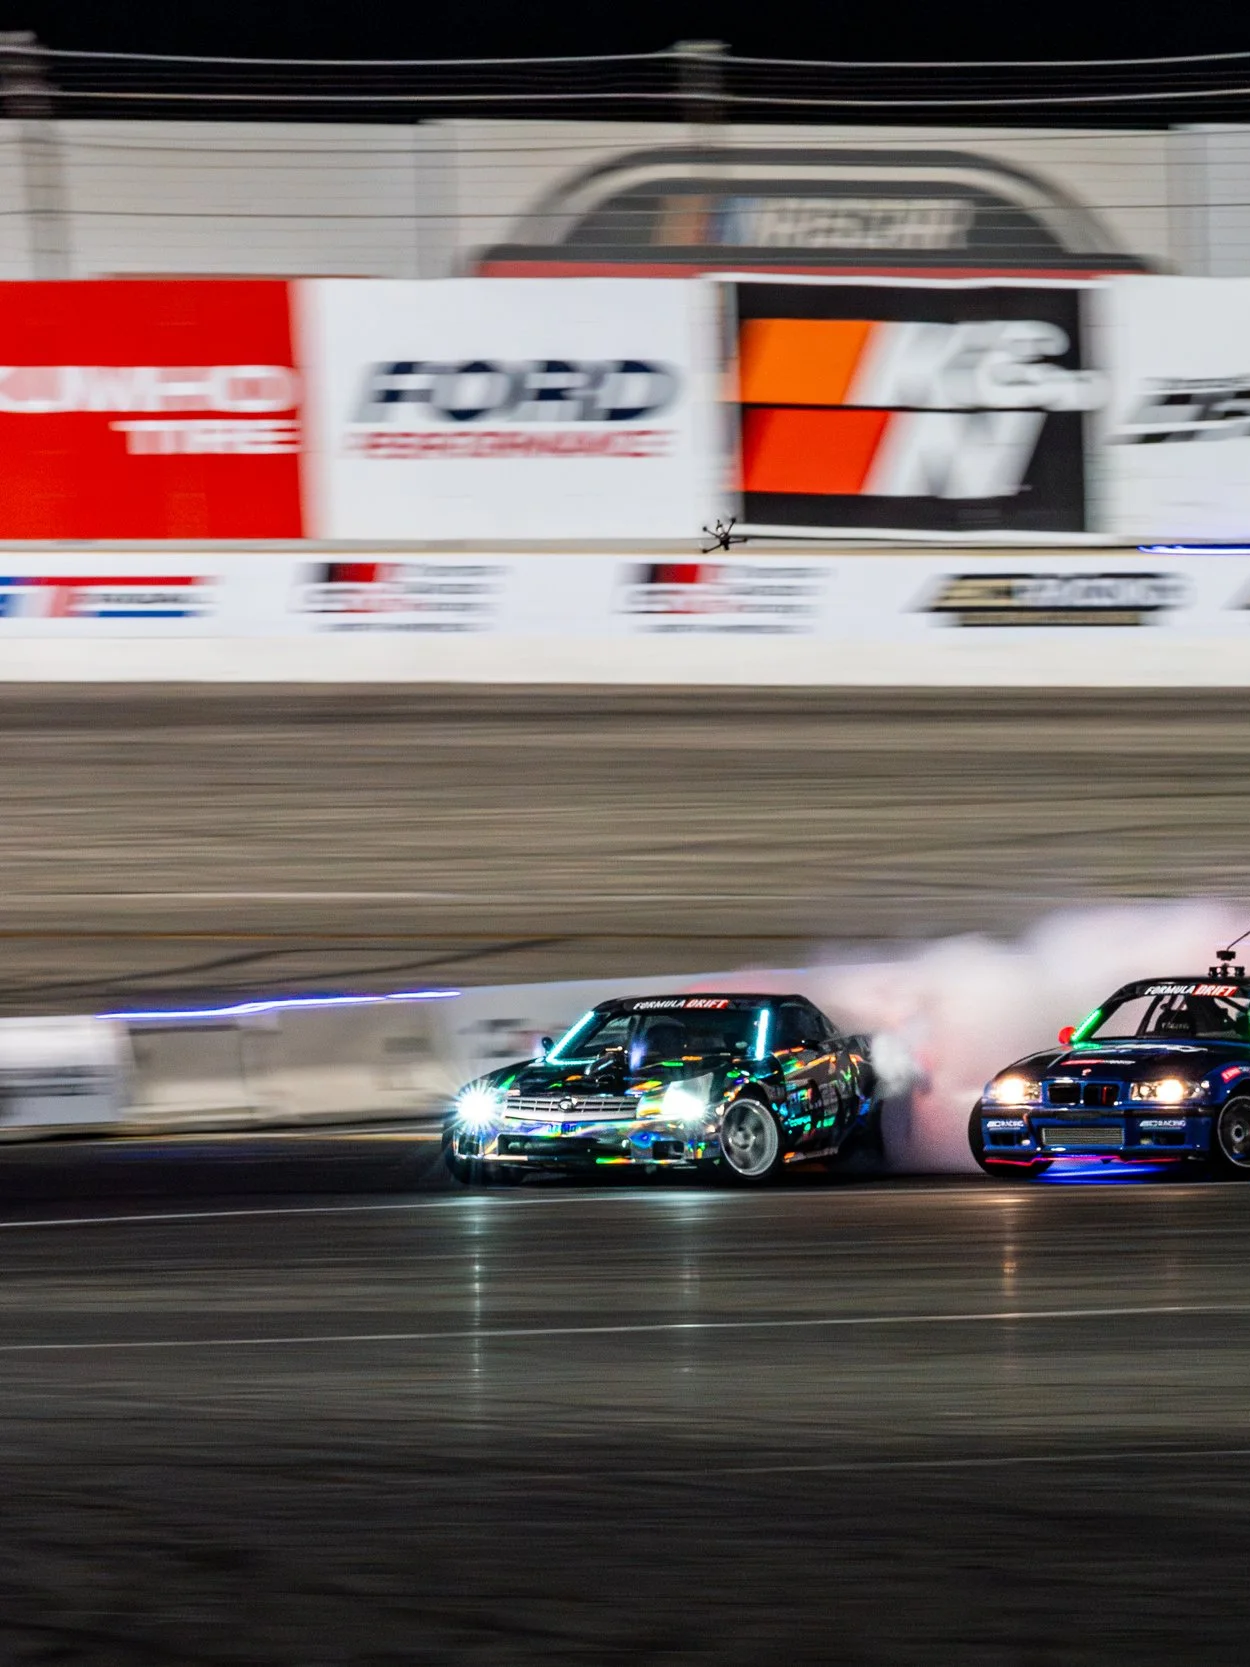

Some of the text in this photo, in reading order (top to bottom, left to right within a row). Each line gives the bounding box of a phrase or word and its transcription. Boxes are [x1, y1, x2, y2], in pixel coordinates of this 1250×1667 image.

[351, 361, 680, 422] FORD
[1144, 984, 1238, 996] FORMULA DRIFT
[633, 999, 730, 1010] FORMULA DRIFT
[1158, 1119, 1187, 1127] RACING
